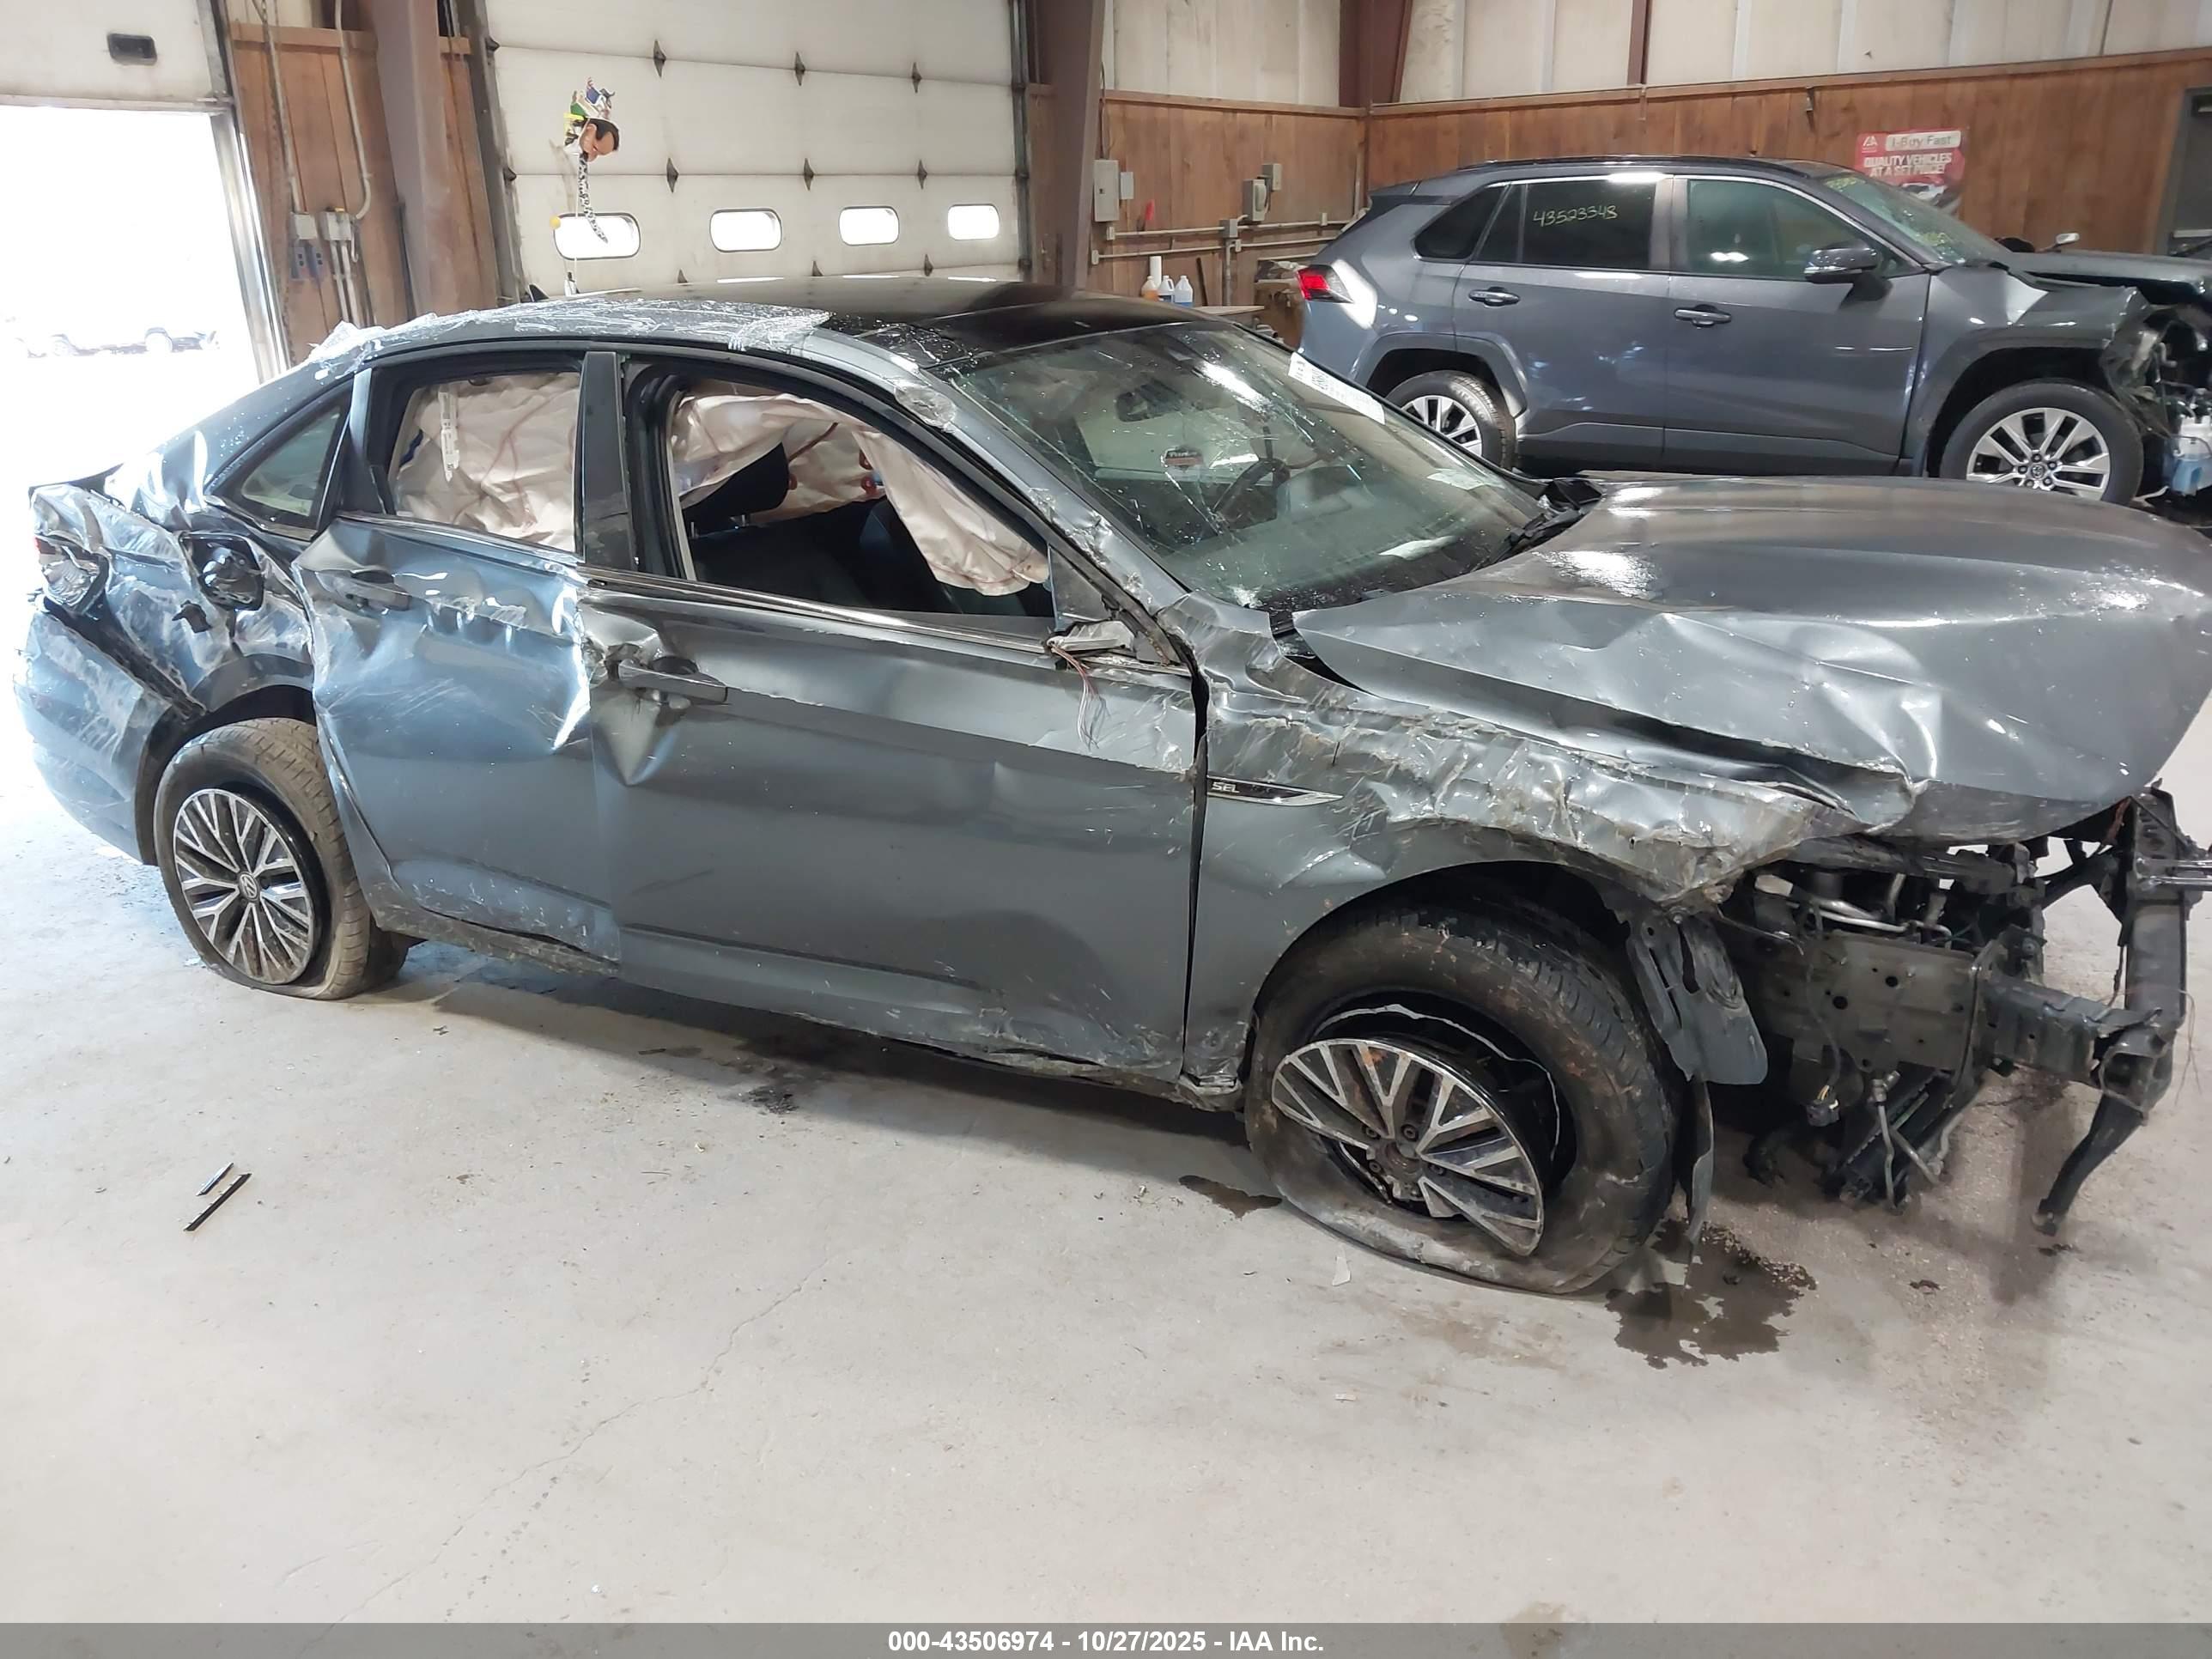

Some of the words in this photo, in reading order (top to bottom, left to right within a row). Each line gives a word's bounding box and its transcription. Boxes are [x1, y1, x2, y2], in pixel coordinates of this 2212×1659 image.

[1927, 135, 1952, 145] Fast
[1863, 155, 1906, 167] QUALITY
[1212, 781, 1240, 793] SEL
